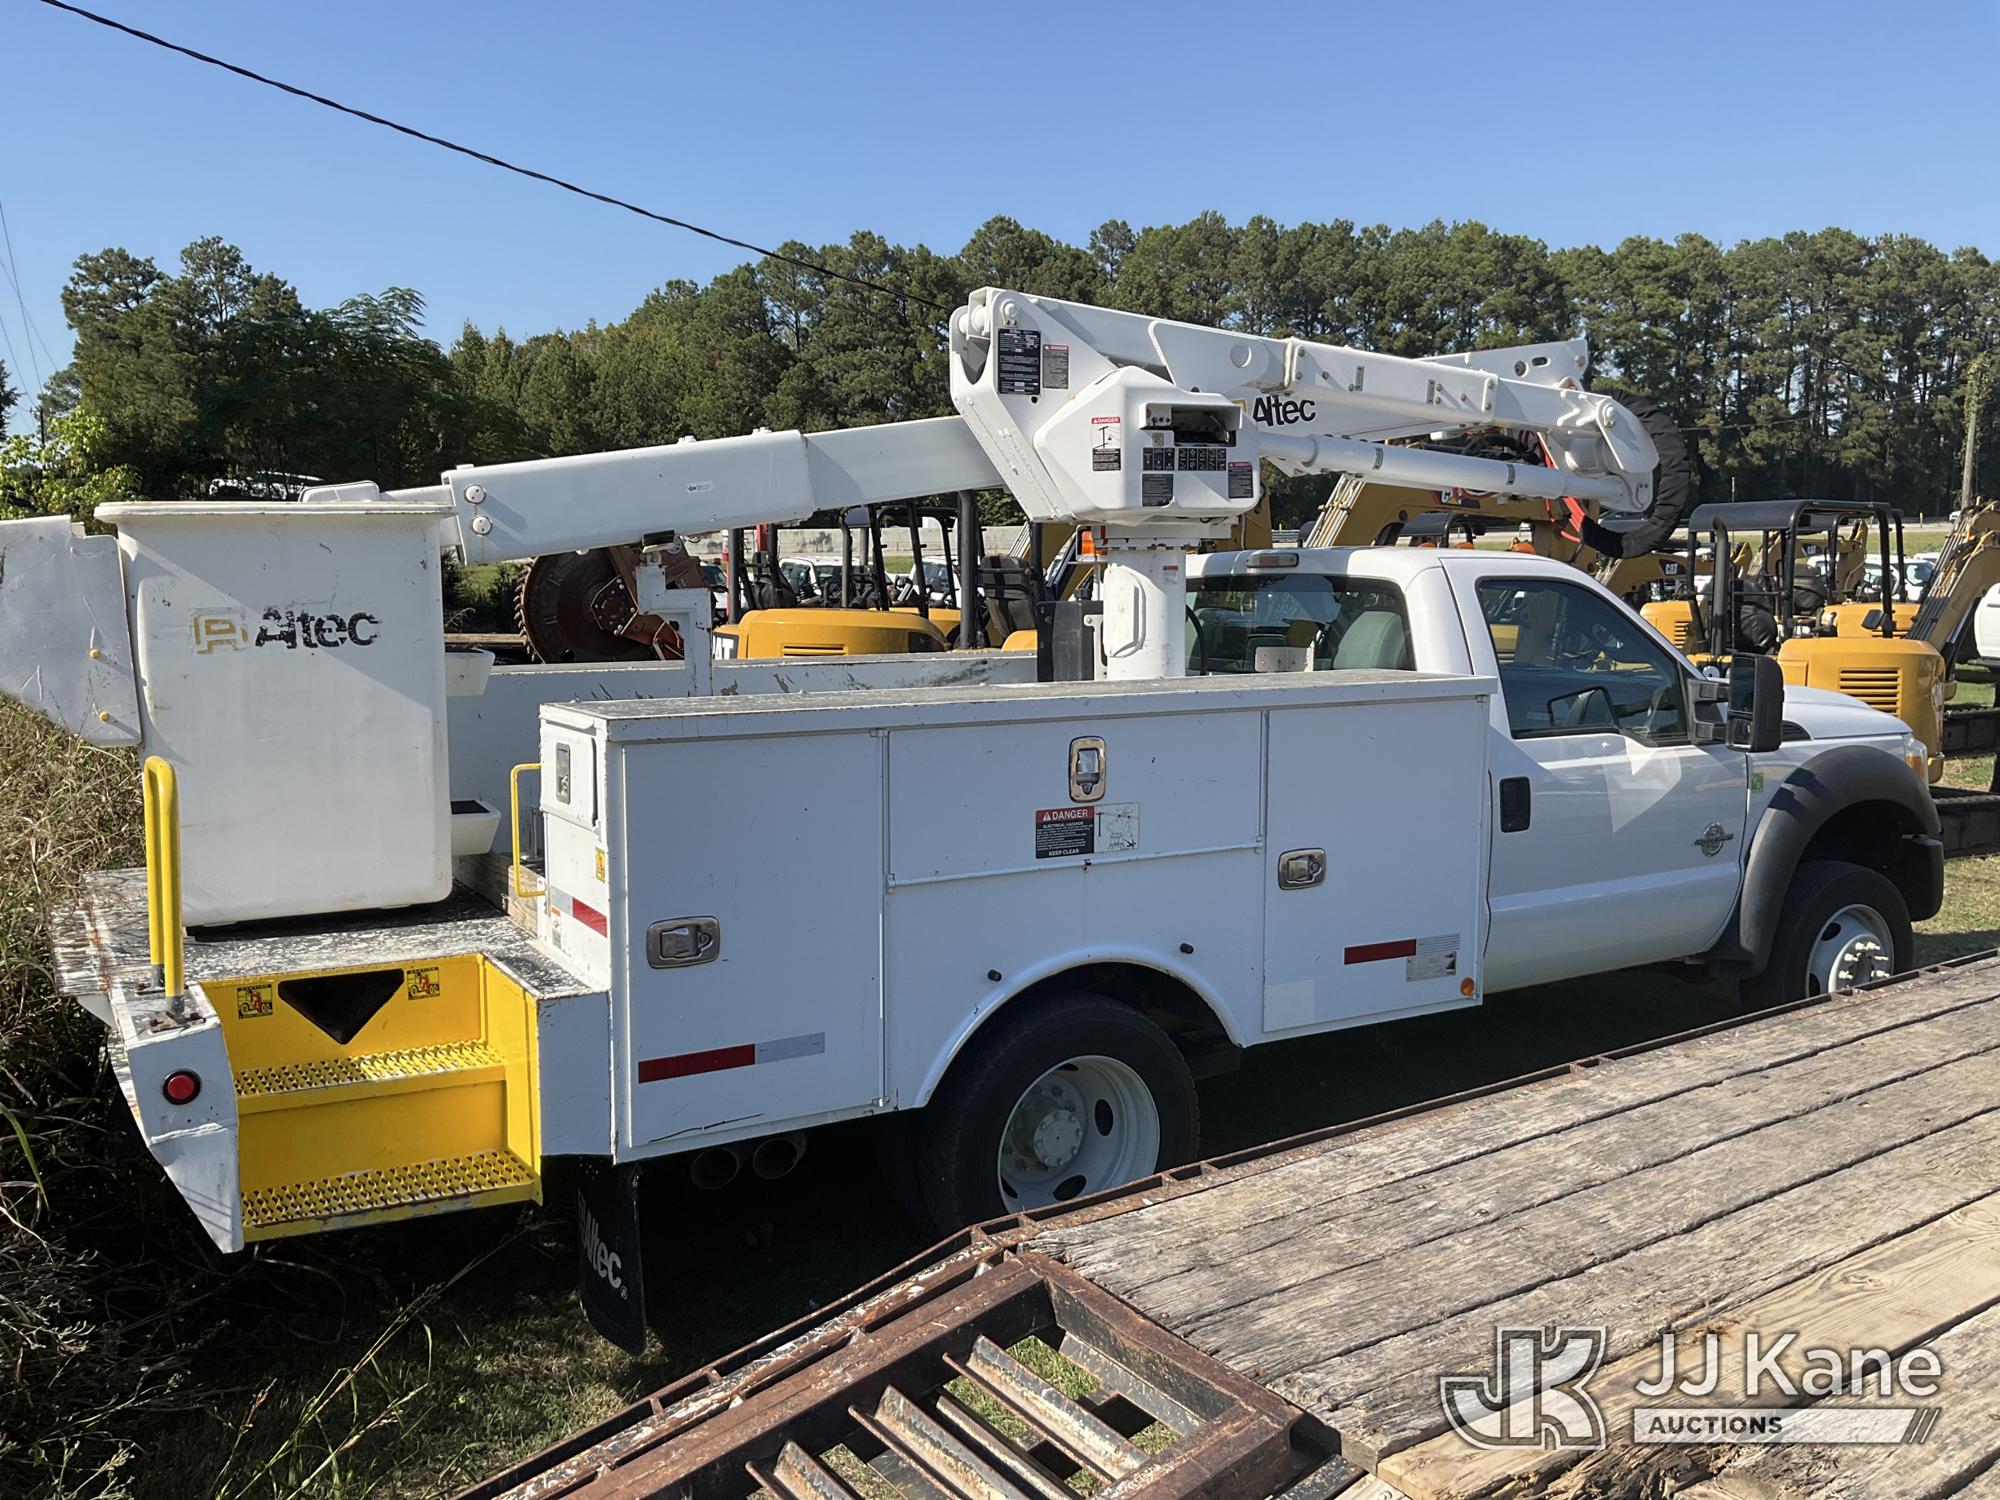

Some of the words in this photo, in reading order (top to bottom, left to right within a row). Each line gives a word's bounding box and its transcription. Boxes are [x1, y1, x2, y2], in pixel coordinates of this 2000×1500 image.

[1253, 394, 1317, 427] Altec
[1665, 562, 1678, 575] CAT
[255, 606, 379, 649] Altec
[1051, 808, 1088, 820] DANGER
[1048, 849, 1062, 857] KEEP
[1062, 847, 1080, 855] CLEAR
